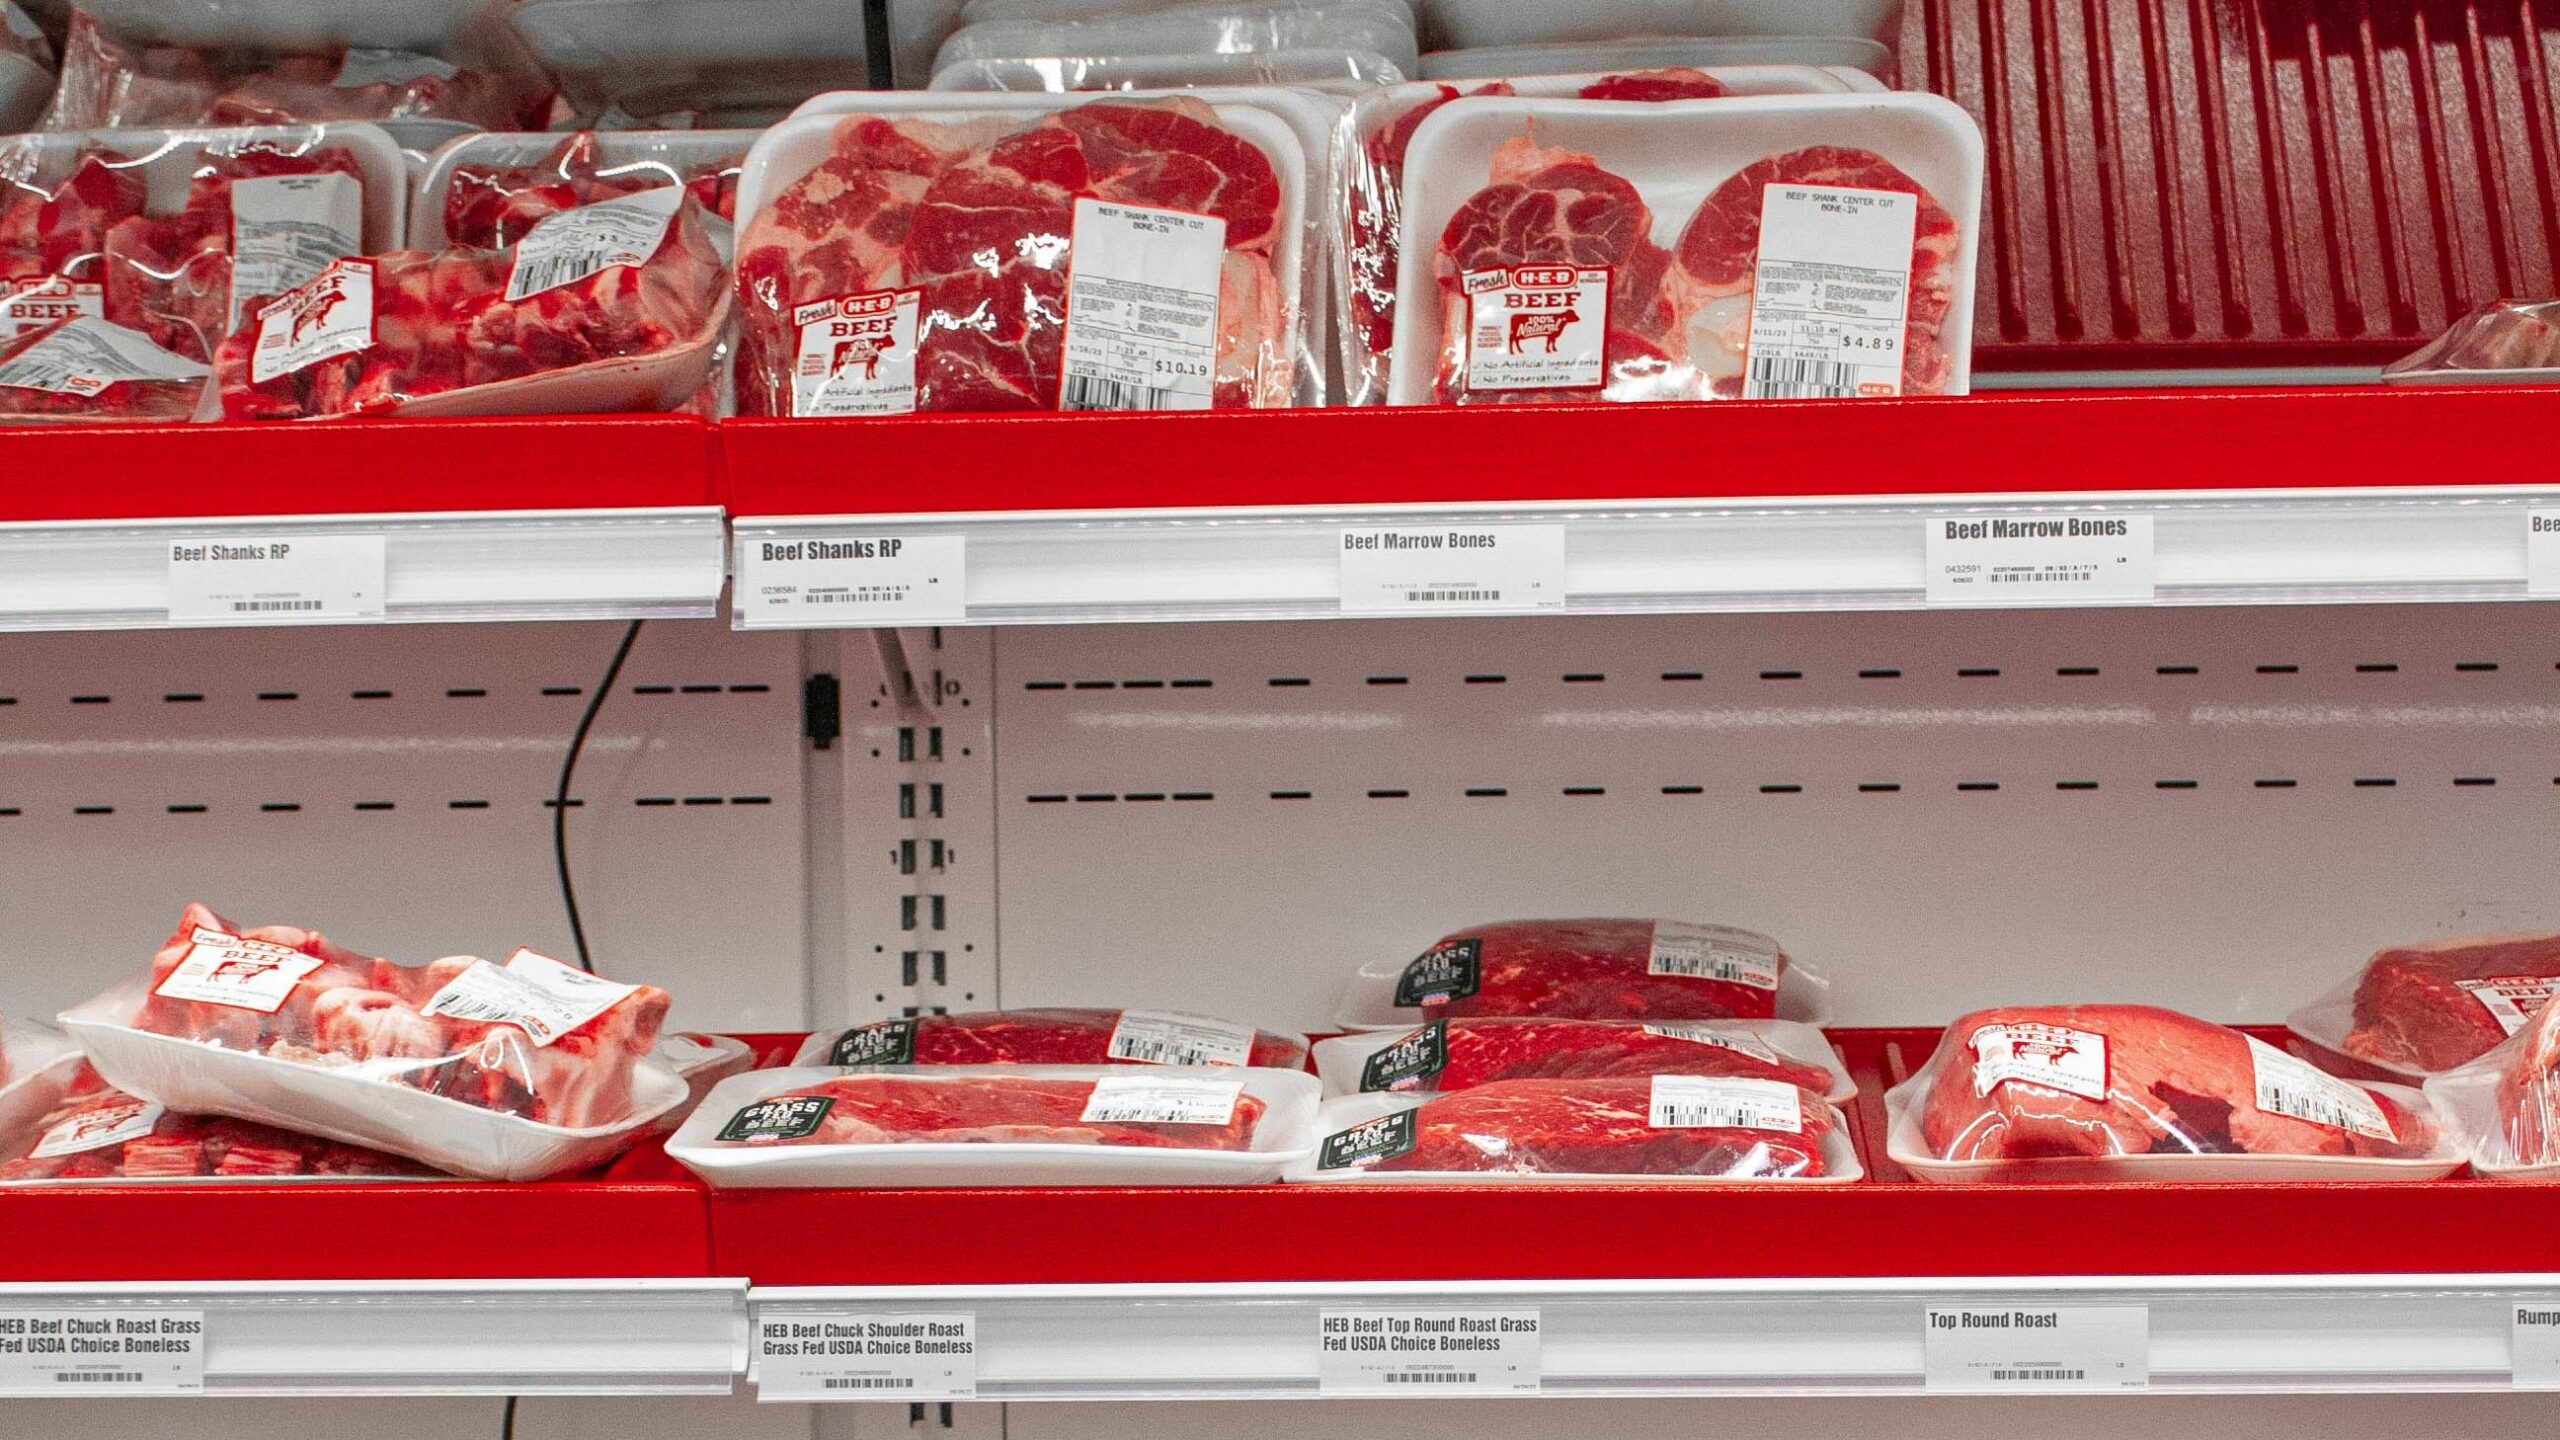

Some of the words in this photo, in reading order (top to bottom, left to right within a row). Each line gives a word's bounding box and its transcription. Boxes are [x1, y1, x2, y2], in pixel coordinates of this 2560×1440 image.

[1786, 191, 1807, 200] BEEF
[1812, 193, 1838, 203] SHANK
[1843, 195, 1874, 206] CENTER
[1879, 199, 1894, 208] CUT
[1821, 204, 1858, 214] BONE-IN
[1099, 207, 1119, 216] BEEF
[1124, 210, 1149, 222] SHANK
[1154, 215, 1185, 228] CENTER
[1189, 219, 1204, 230] CUT
[1133, 222, 1169, 234] BONE-IN
[1468, 271, 1505, 291] Fresh
[1504, 292, 1582, 309] BEEF
[830, 315, 898, 337] BEEF
[1842, 335, 1895, 351] $4.89
[1154, 359, 1208, 377] $10.19
[1502, 359, 1545, 370] Artificial
[1502, 374, 1571, 384] Preservatives
[1945, 520, 1988, 539] Beef
[1992, 519, 2065, 538] Marrow
[2068, 517, 2127, 536] Bones
[762, 541, 803, 561] Beef
[808, 539, 875, 560] Shanks
[879, 538, 902, 557] RP
[1344, 534, 1379, 550] Beef
[1384, 532, 1443, 549] Marrow
[1449, 532, 1496, 548] Bones
[174, 544, 207, 561] Beef
[211, 543, 265, 560] Shanks
[270, 543, 290, 559] RP
[744, 1101, 820, 1118] GRASS
[745, 1117, 806, 1129] BEEF
[1333, 1115, 1404, 1147] GRASS
[0, 1318, 25, 1334] HEB
[31, 1318, 62, 1334] Beef
[67, 1318, 112, 1334] Chuck
[116, 1318, 156, 1334] Roast
[161, 1318, 201, 1334] Grass
[1323, 1317, 1349, 1332] HEB
[1353, 1317, 1383, 1332] Beef
[1387, 1317, 1410, 1334] Top
[1414, 1317, 1455, 1332] Round
[1459, 1317, 1496, 1332] Roast
[1500, 1317, 1537, 1332] Grass
[1930, 1312, 1957, 1330] Top
[1961, 1312, 2010, 1328] Round
[2014, 1312, 2058, 1328] Roast
[2517, 1309, 2560, 1326] Rump
[763, 1324, 788, 1338] HEB
[793, 1323, 821, 1338] Beef
[825, 1323, 864, 1337] Chuck
[868, 1322, 925, 1337] Shoulder
[929, 1322, 964, 1337] Roast
[28, 1338, 65, 1353] USDA
[71, 1337, 120, 1353] Choice
[125, 1337, 190, 1353] Boneless
[763, 1340, 798, 1355] Grass
[802, 1341, 825, 1355] Fed
[829, 1340, 863, 1355] USDA
[867, 1340, 911, 1354] Choice
[915, 1340, 973, 1354] Boneless
[1323, 1336, 1347, 1351] Fed
[1351, 1336, 1387, 1351] USDA
[1391, 1336, 1436, 1351] Choice
[1440, 1335, 1500, 1351] Boneless
